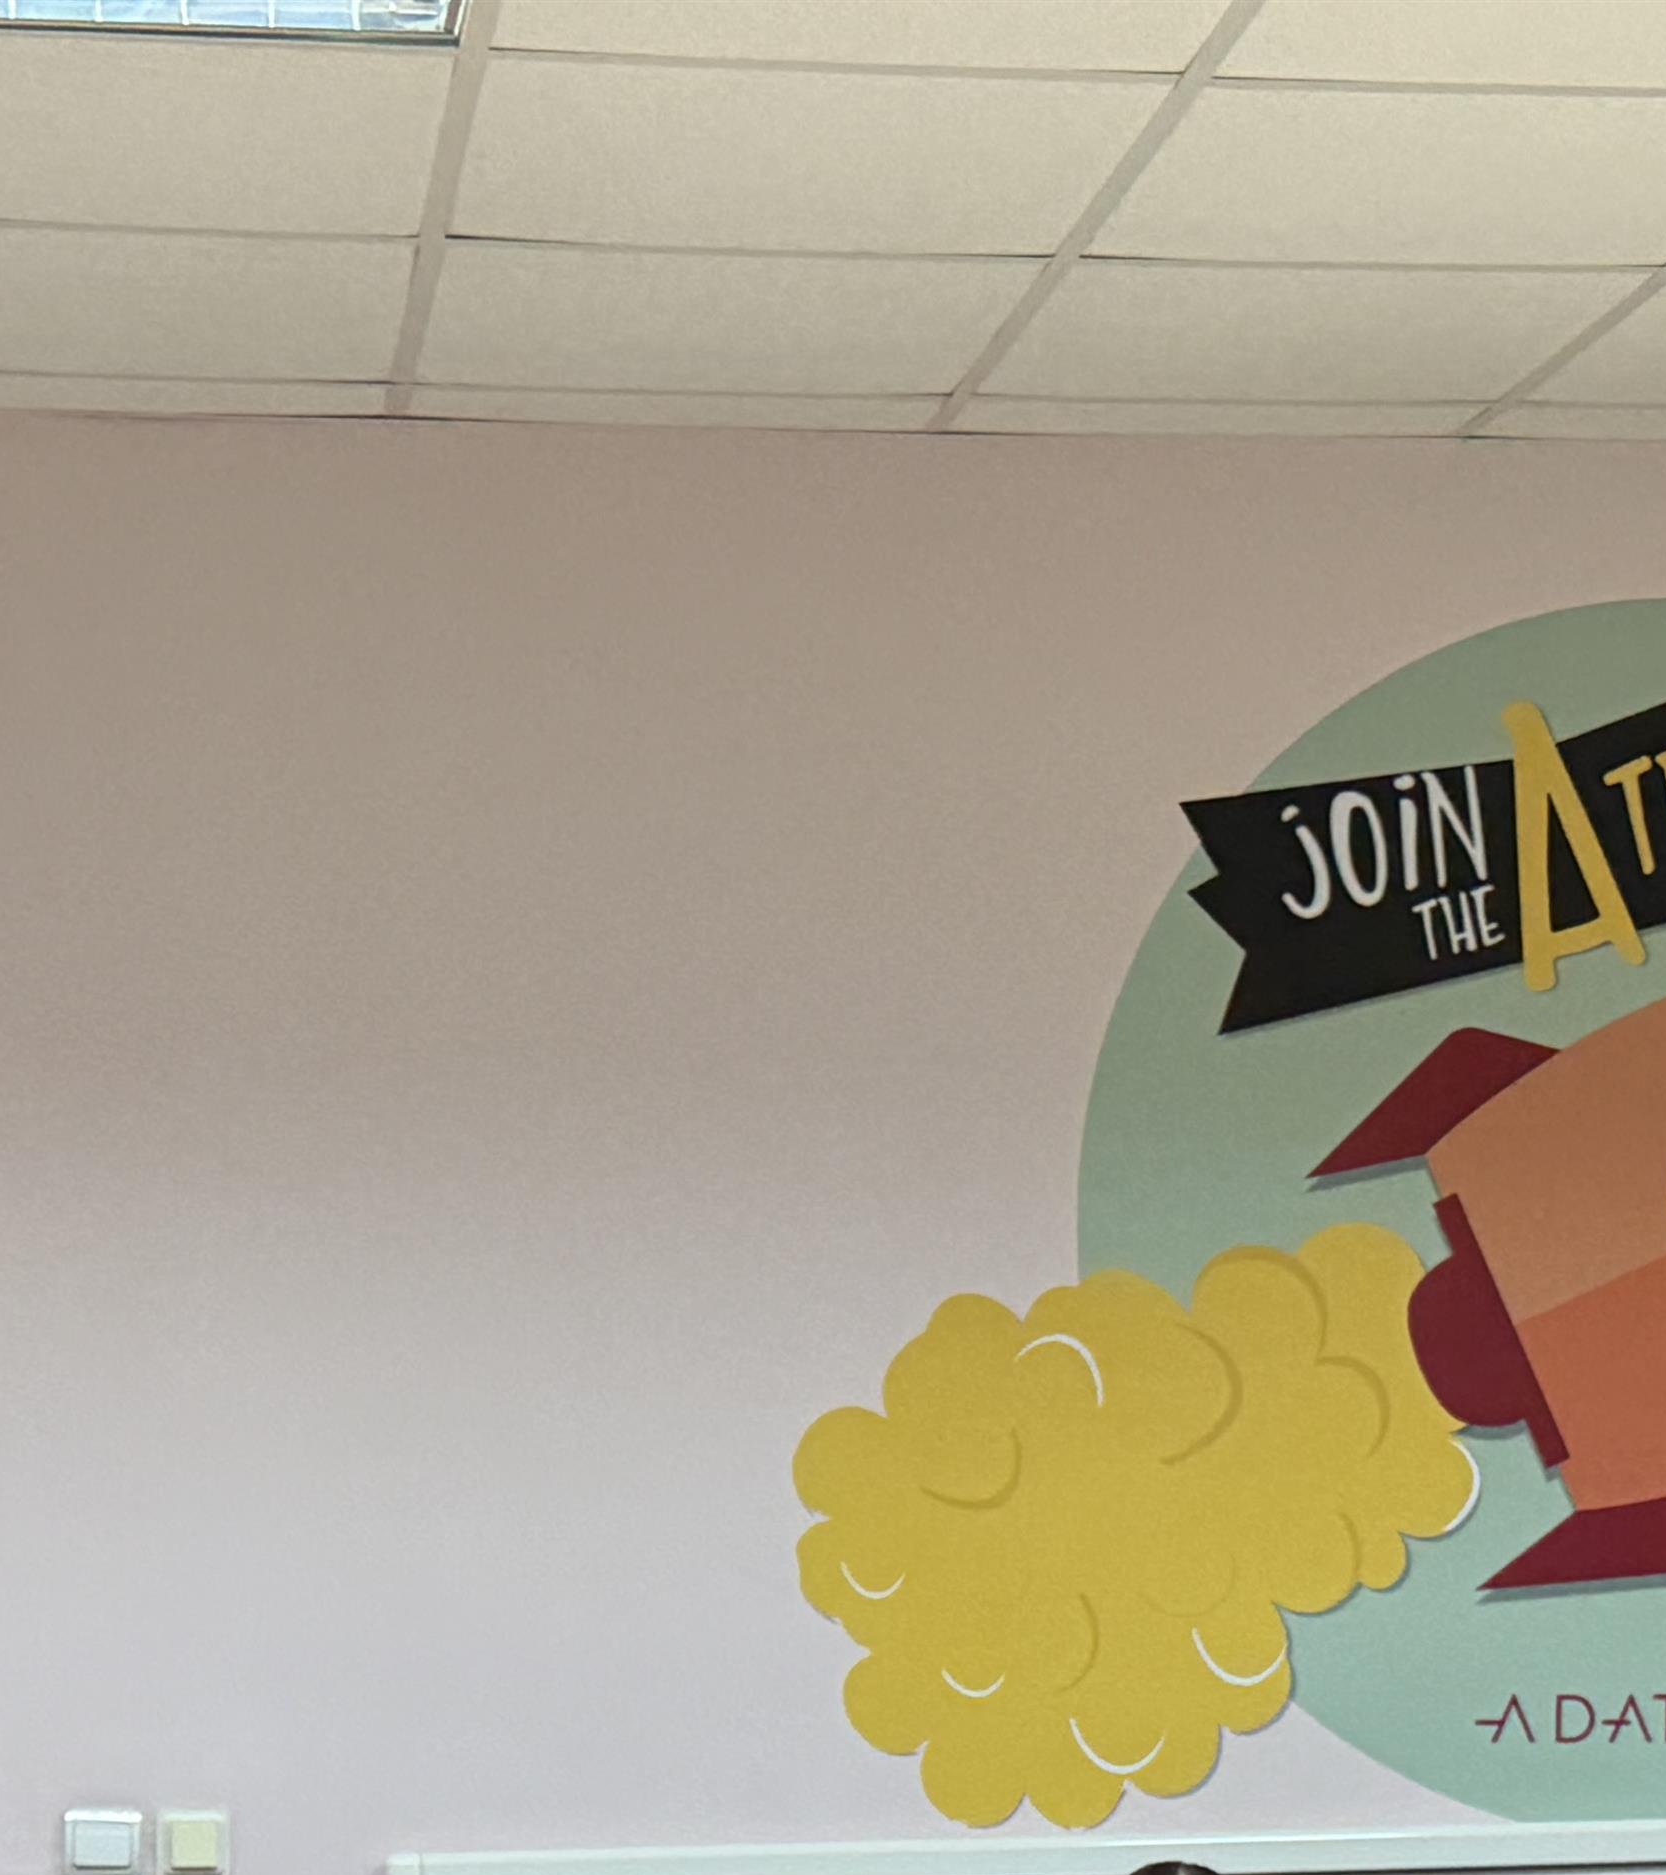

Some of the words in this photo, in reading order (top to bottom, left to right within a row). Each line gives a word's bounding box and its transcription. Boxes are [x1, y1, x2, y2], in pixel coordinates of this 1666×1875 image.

[1502, 701, 1646, 992] A
[1411, 886, 1506, 961] THE
[1474, 1693, 1536, 1744] A
